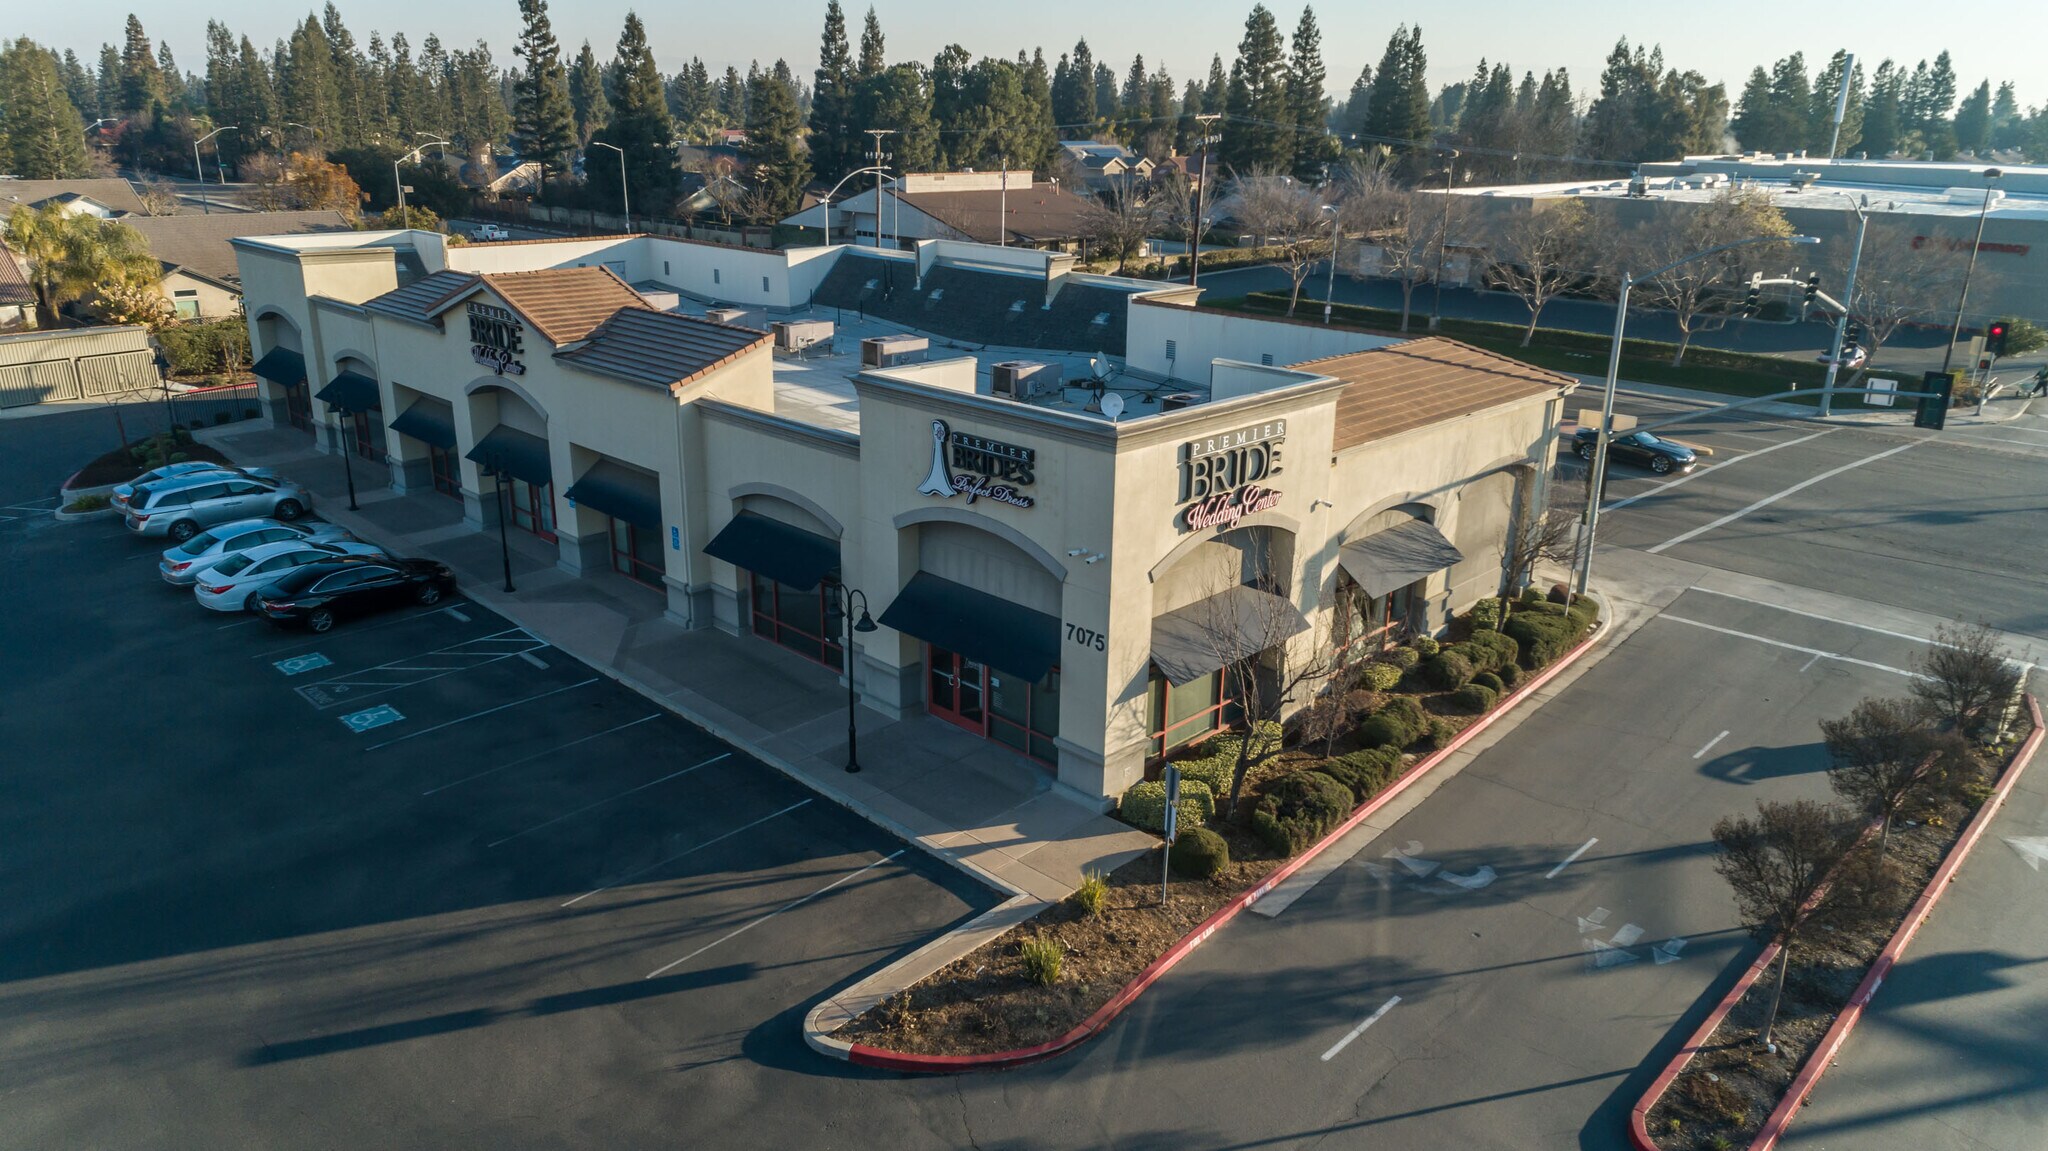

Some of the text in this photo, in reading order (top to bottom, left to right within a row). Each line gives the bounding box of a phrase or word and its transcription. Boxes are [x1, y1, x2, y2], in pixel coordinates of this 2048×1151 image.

[466, 302, 514, 322] PREMIE
[468, 314, 523, 354] BRIDE
[952, 434, 1029, 460] PREMIER
[1192, 421, 1285, 456] PREMIER
[1184, 437, 1286, 503] BRIDE
[952, 475, 1031, 508] Perfect Dress
[1187, 485, 1283, 530] Wedding Center
[1066, 622, 1105, 652] 7075
